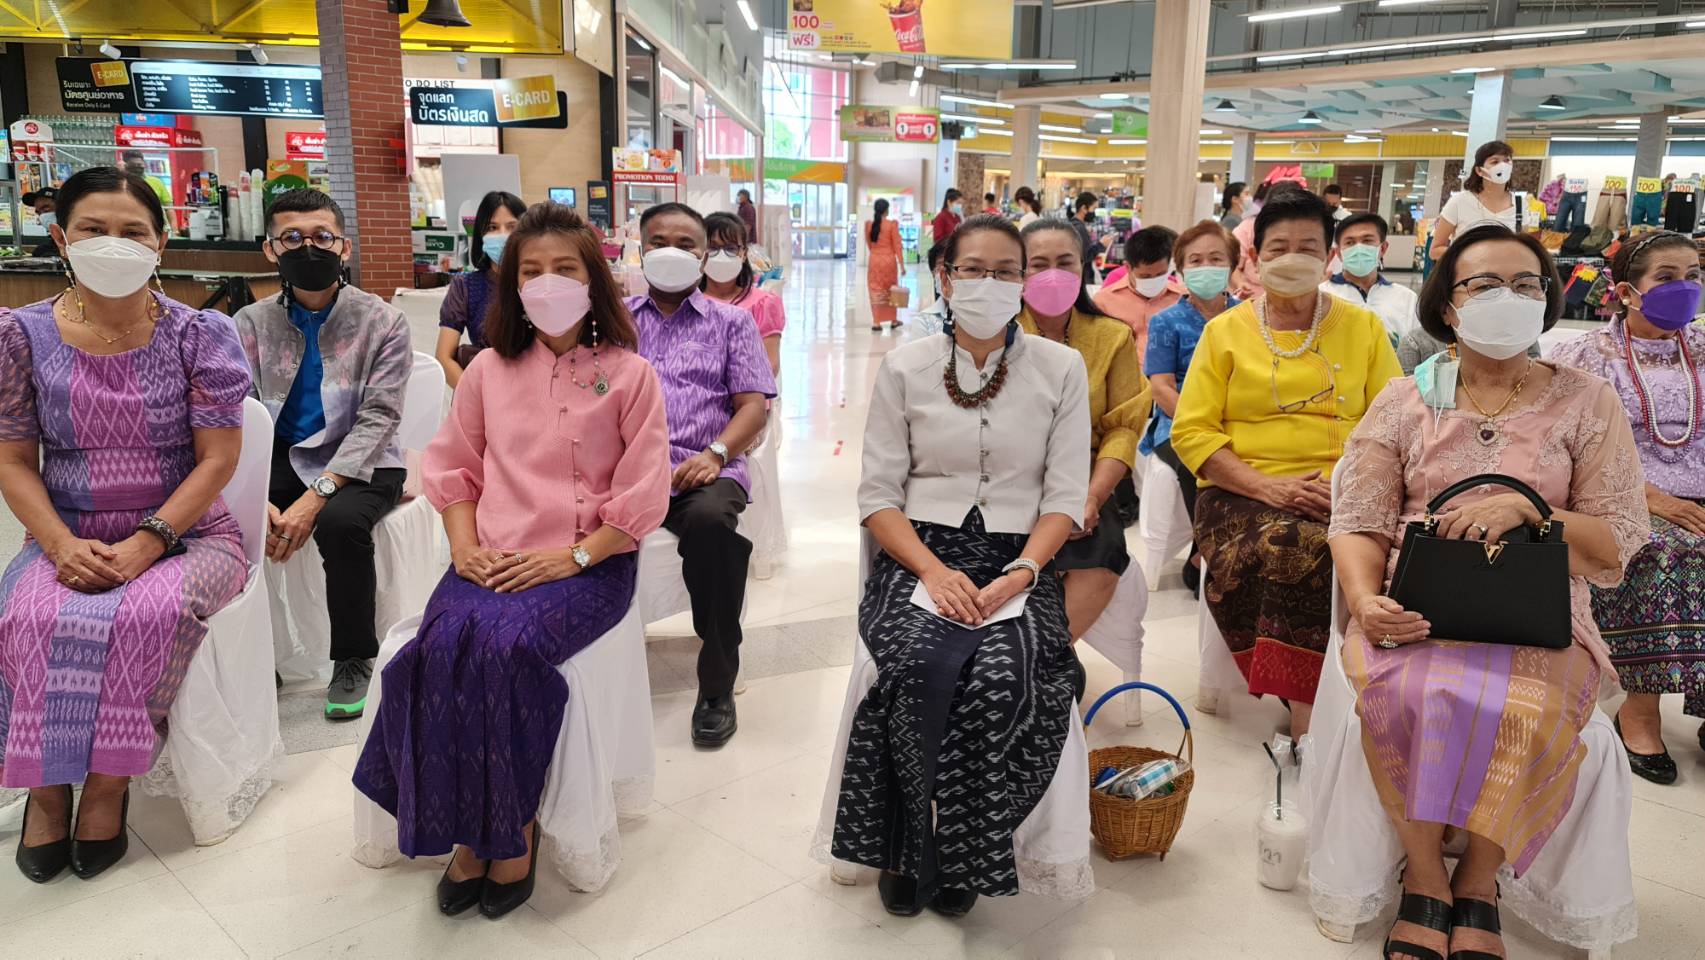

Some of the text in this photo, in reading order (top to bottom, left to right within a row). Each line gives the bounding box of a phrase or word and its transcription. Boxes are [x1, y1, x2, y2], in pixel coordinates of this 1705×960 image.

[792, 15, 819, 29] 100
[97, 69, 125, 79] E-CARD
[418, 92, 454, 106] จุดแลก
[502, 90, 550, 108] E-CARD
[418, 105, 489, 122] บัตรเงินสด
[614, 173, 675, 182] PROMOTION TODAY
[1605, 179, 1621, 190] 100
[1638, 182, 1655, 192] 100
